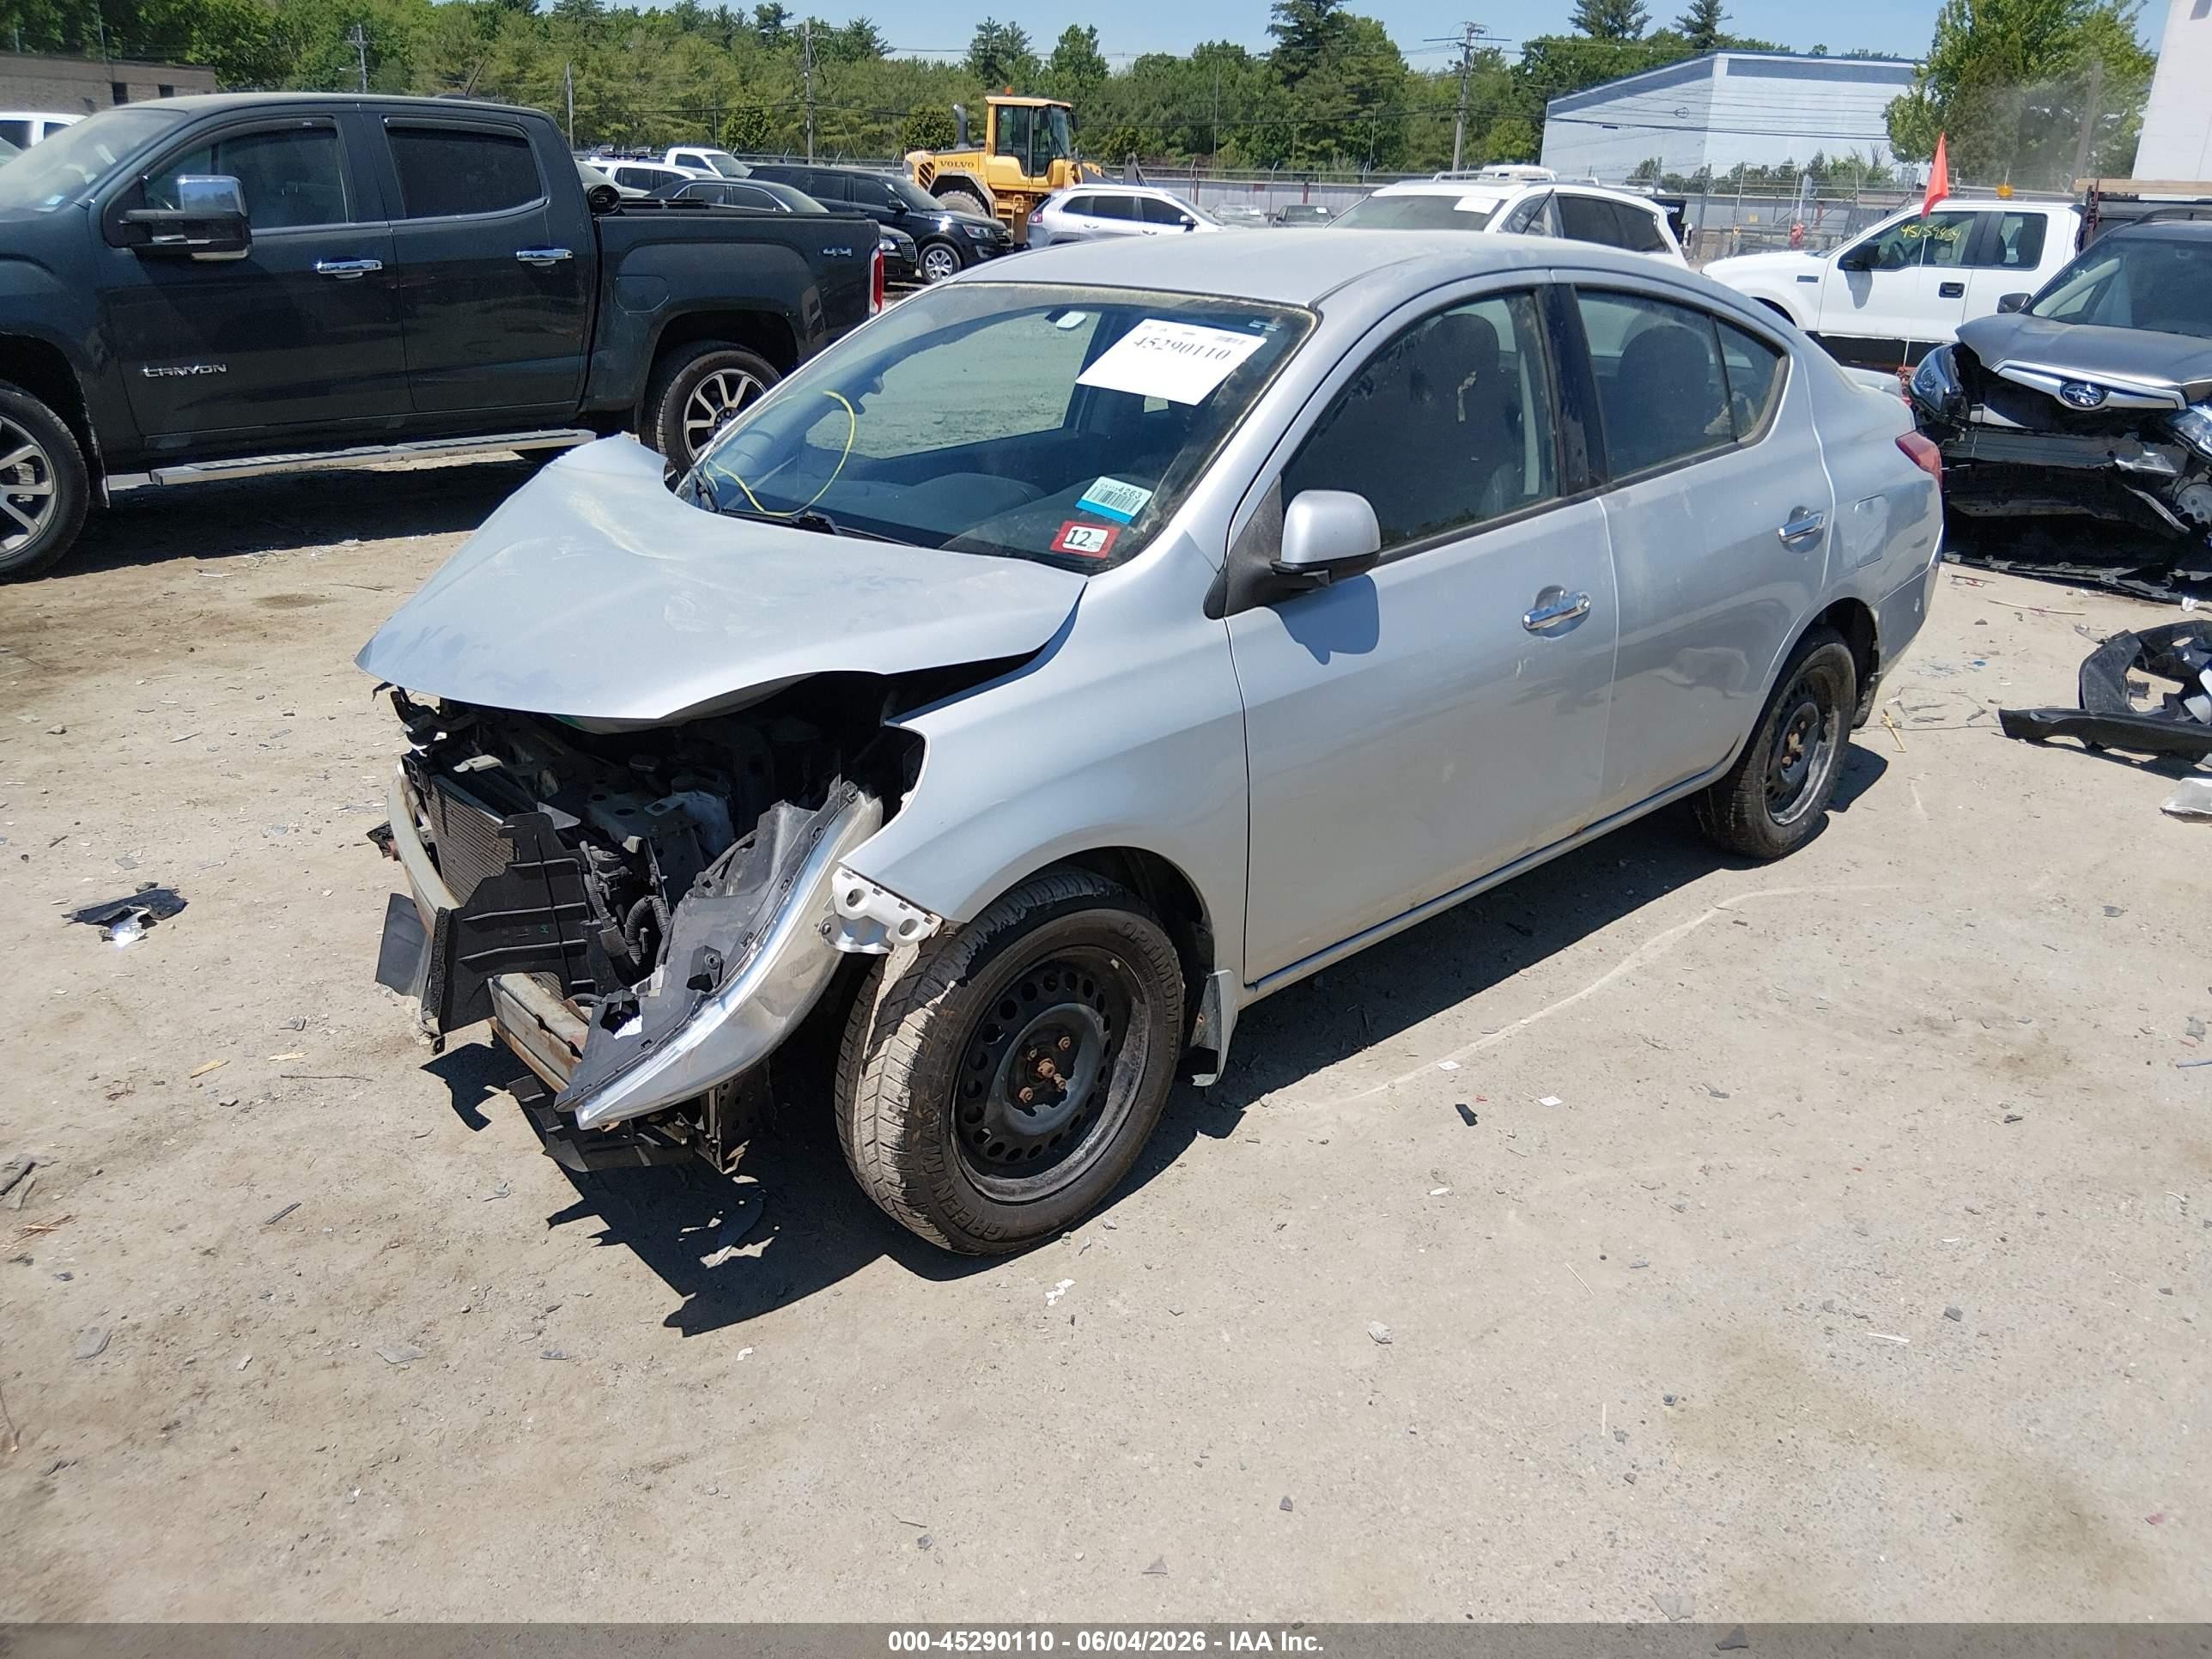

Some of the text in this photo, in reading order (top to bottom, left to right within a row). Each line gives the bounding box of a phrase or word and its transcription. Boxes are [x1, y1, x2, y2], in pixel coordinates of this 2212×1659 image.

[940, 160, 975, 168] VOLVO
[1133, 336, 1232, 361] 45290110
[143, 364, 228, 378] CANYON
[1064, 529, 1092, 547] 12
[1117, 918, 1180, 1024] OPTIMUM
[930, 1177, 1008, 1243] GREEN
